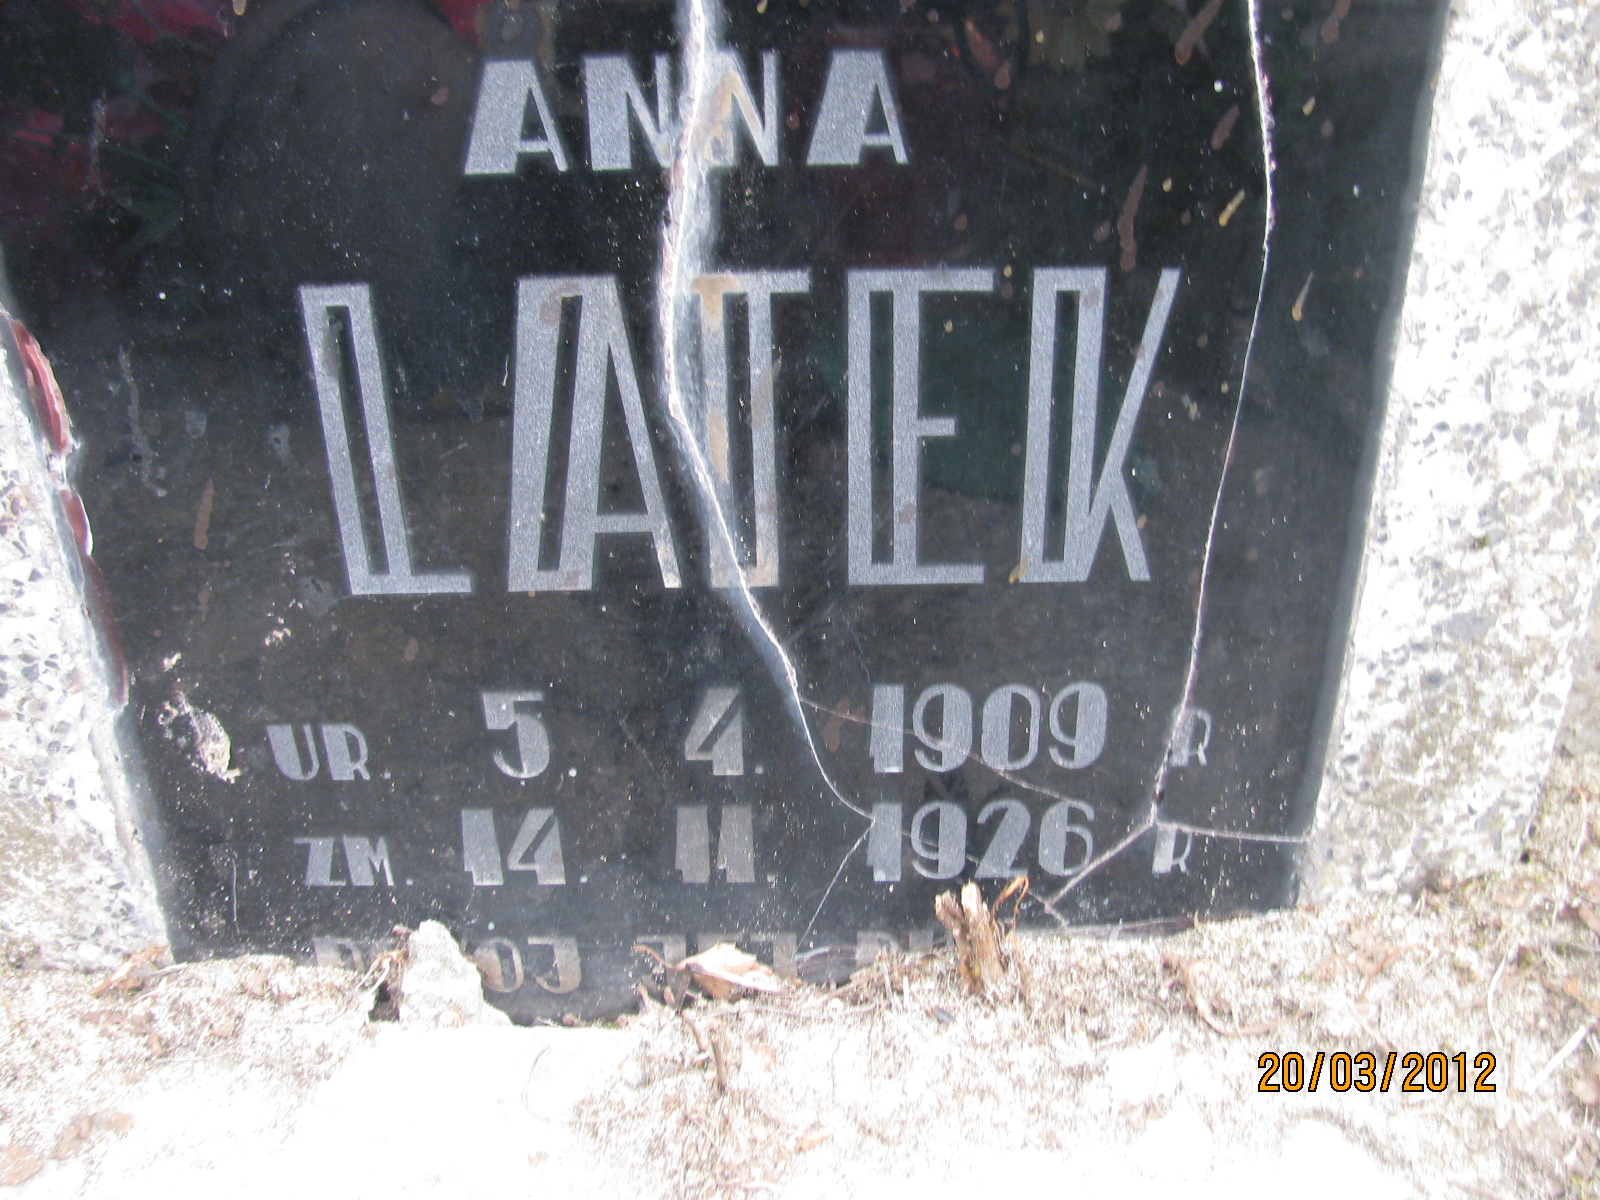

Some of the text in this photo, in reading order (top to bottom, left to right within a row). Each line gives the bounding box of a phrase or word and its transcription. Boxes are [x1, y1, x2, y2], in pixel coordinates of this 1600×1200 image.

[464, 48, 909, 176] ANNA
[298, 267, 1181, 597] LATEK
[267, 681, 1211, 781] UR. 5. 4. 1909 R
[294, 836, 413, 887] ZM.
[461, 808, 588, 886] 14.
[866, 800, 1095, 882] 1926
[1152, 822, 1193, 874] R
